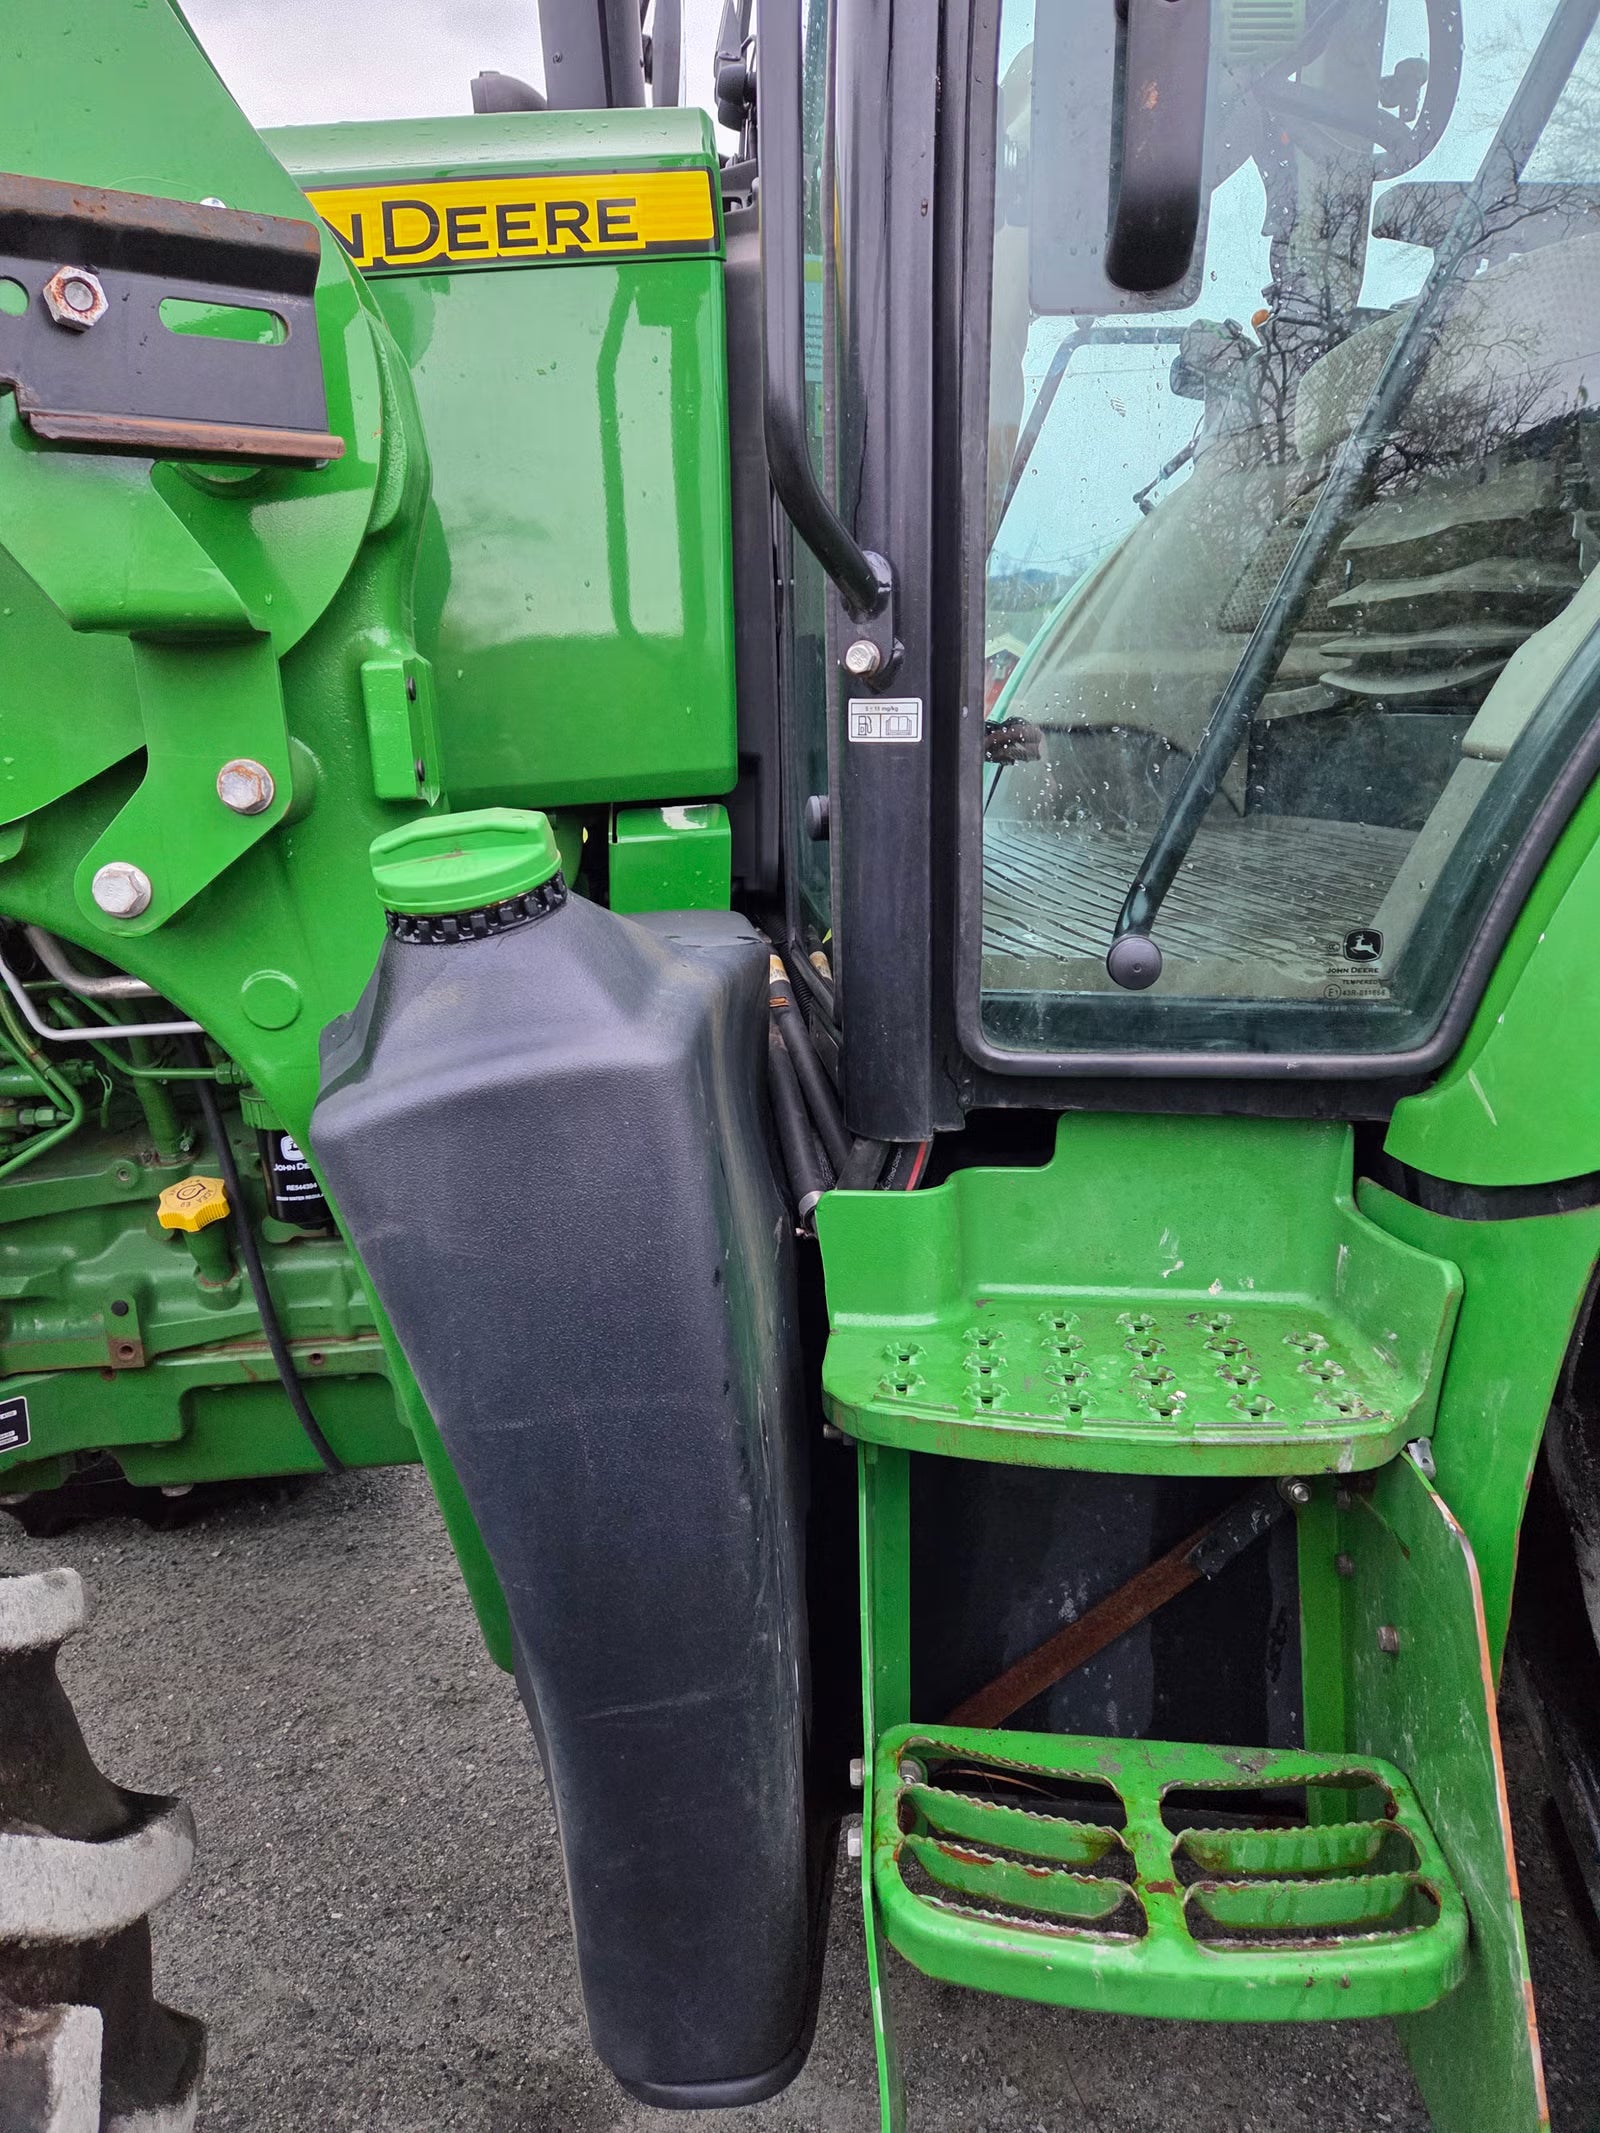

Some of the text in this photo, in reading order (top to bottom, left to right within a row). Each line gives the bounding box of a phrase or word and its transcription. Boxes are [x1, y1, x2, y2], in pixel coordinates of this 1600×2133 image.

[381, 197, 638, 257] DEERE
[1351, 966, 1379, 974] DEERE
[274, 1163, 296, 1172] JOHN
